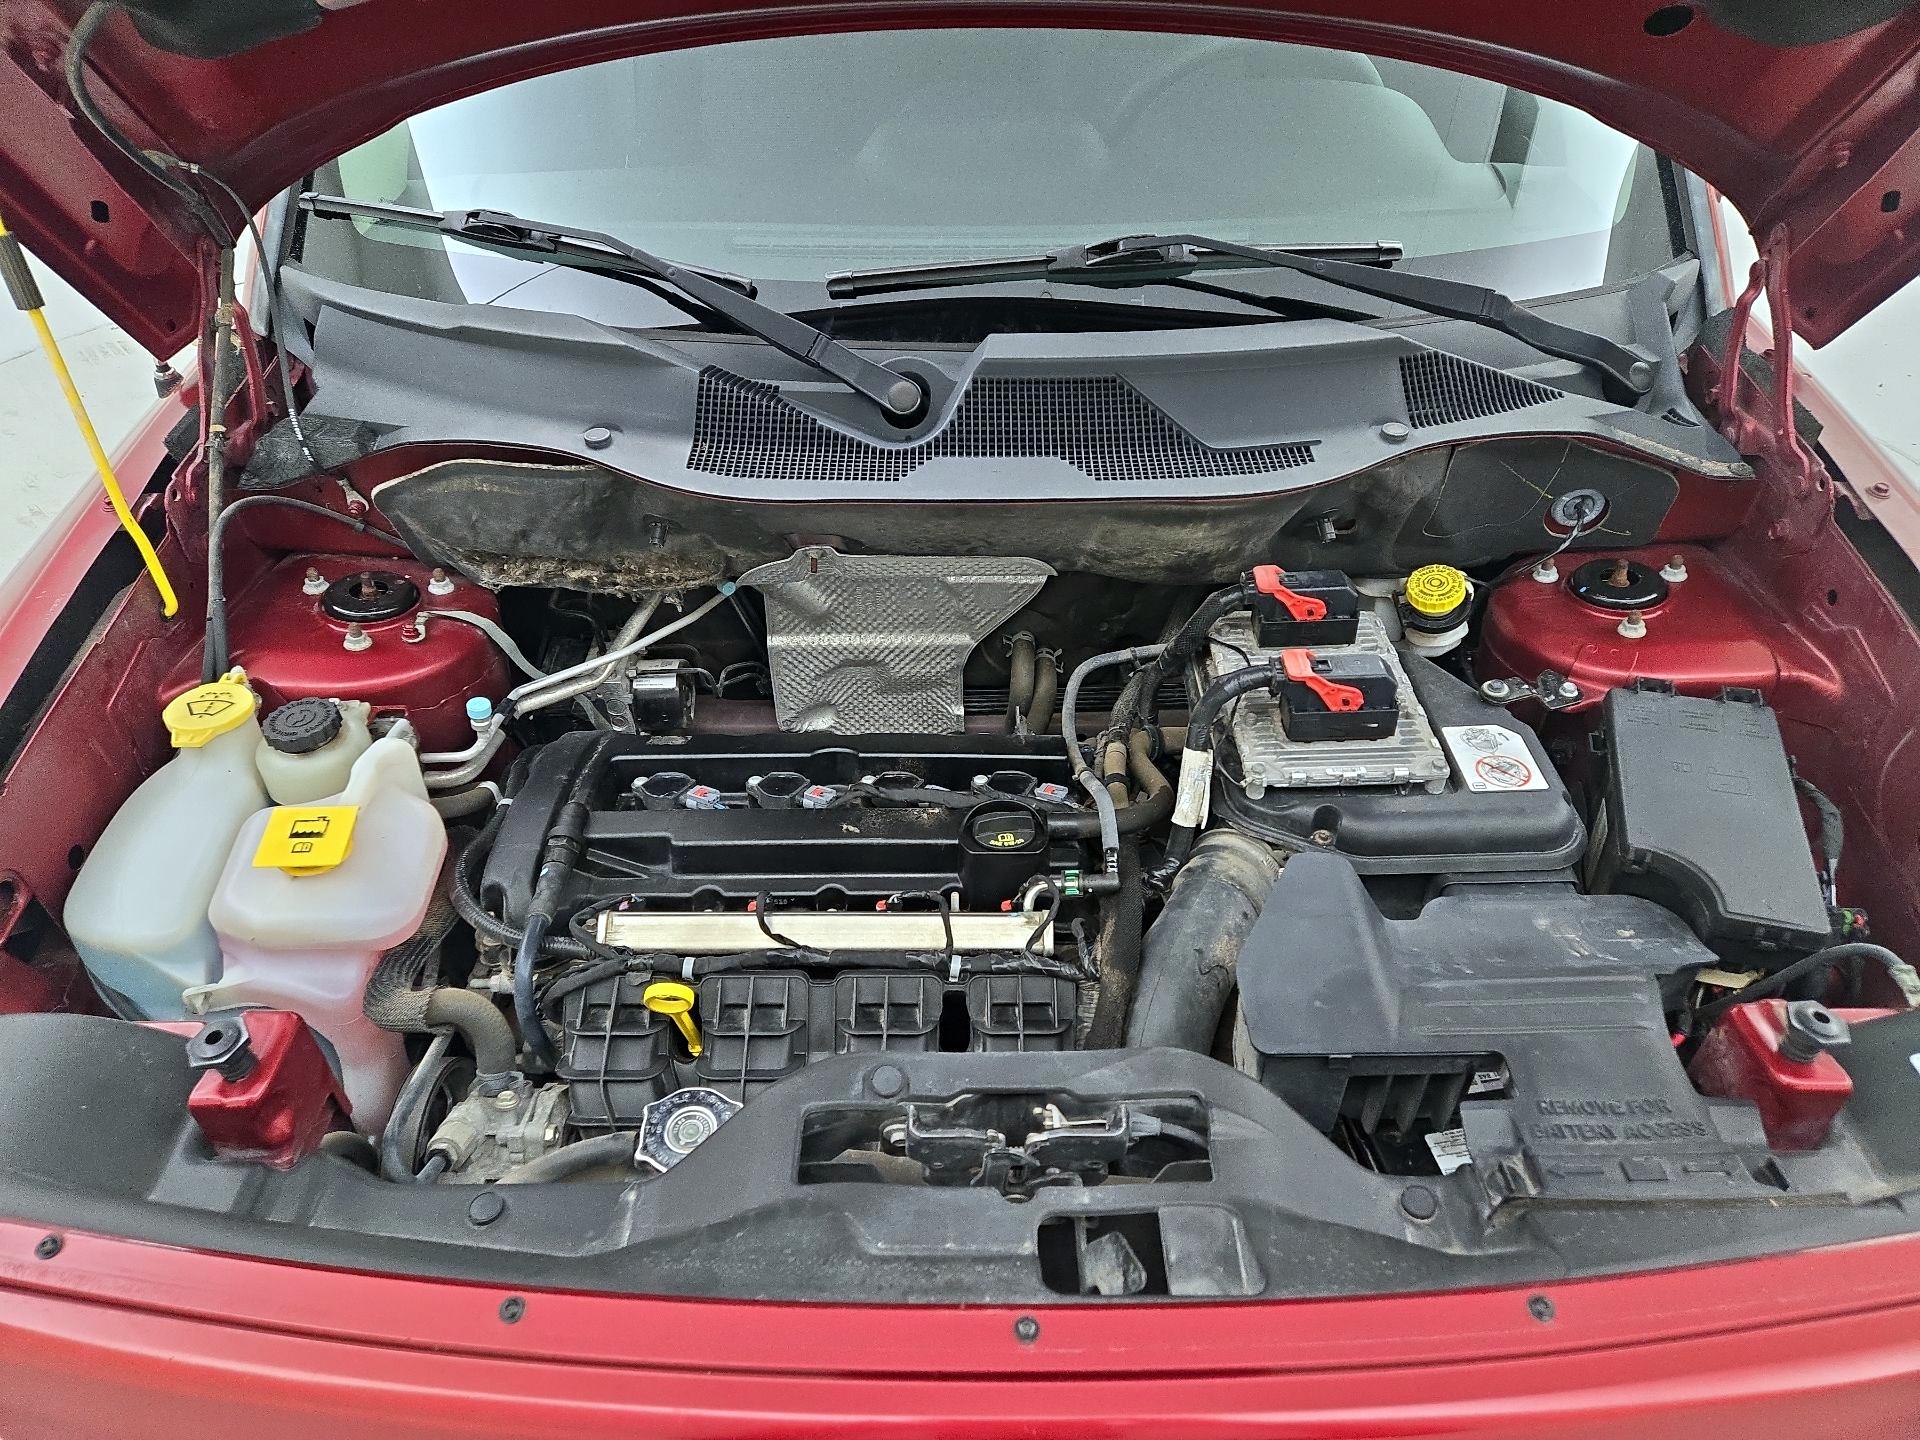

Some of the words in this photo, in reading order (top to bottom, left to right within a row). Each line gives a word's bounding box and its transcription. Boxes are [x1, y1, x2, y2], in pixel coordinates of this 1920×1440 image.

[1537, 1099, 1625, 1116] REMOVE
[1628, 1098, 1673, 1115] FOR
[1531, 1122, 1617, 1141] BATTERY
[1623, 1120, 1707, 1140] ACCESS
